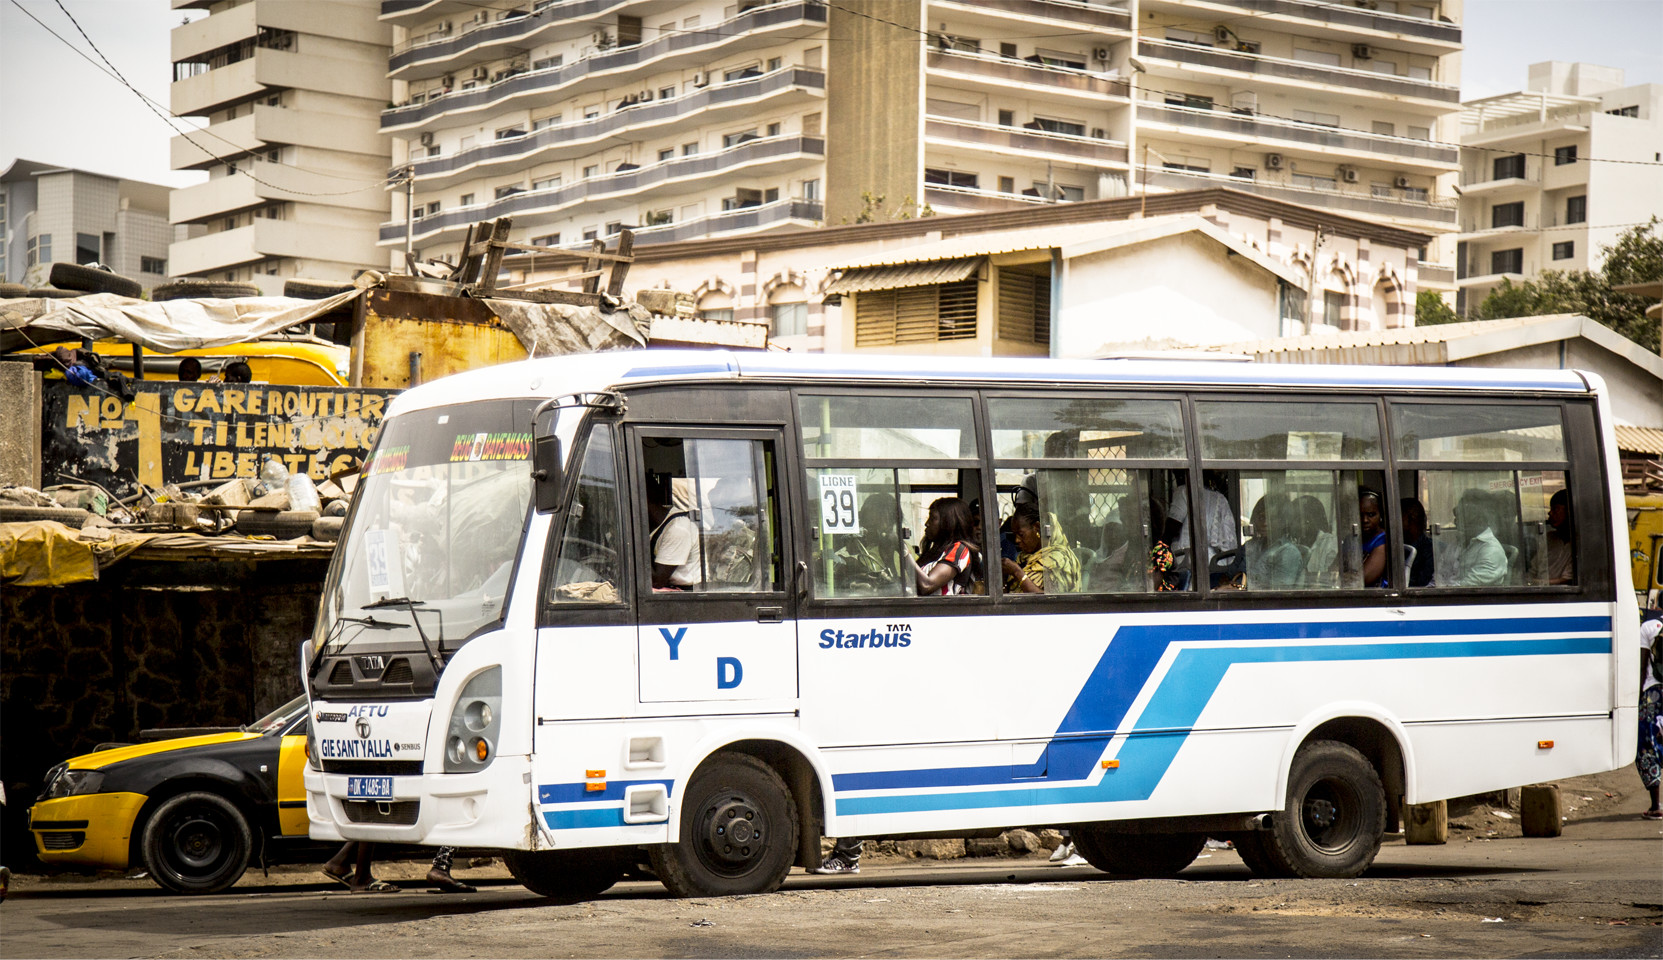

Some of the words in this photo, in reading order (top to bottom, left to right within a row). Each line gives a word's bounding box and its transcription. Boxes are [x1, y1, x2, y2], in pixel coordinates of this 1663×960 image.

[173, 388, 263, 415] GARE
[124, 391, 164, 490] 1
[822, 476, 854, 487] LIGNE
[1490, 479, 1528, 489] EMERGECY
[823, 490, 855, 528] 39
[886, 623, 912, 632] TATA
[658, 627, 688, 661] Y
[818, 628, 912, 649] Starbus
[716, 656, 743, 690] D
[348, 705, 389, 718] AFTU
[321, 739, 336, 758] GIE
[400, 742, 421, 751] SENBUS
